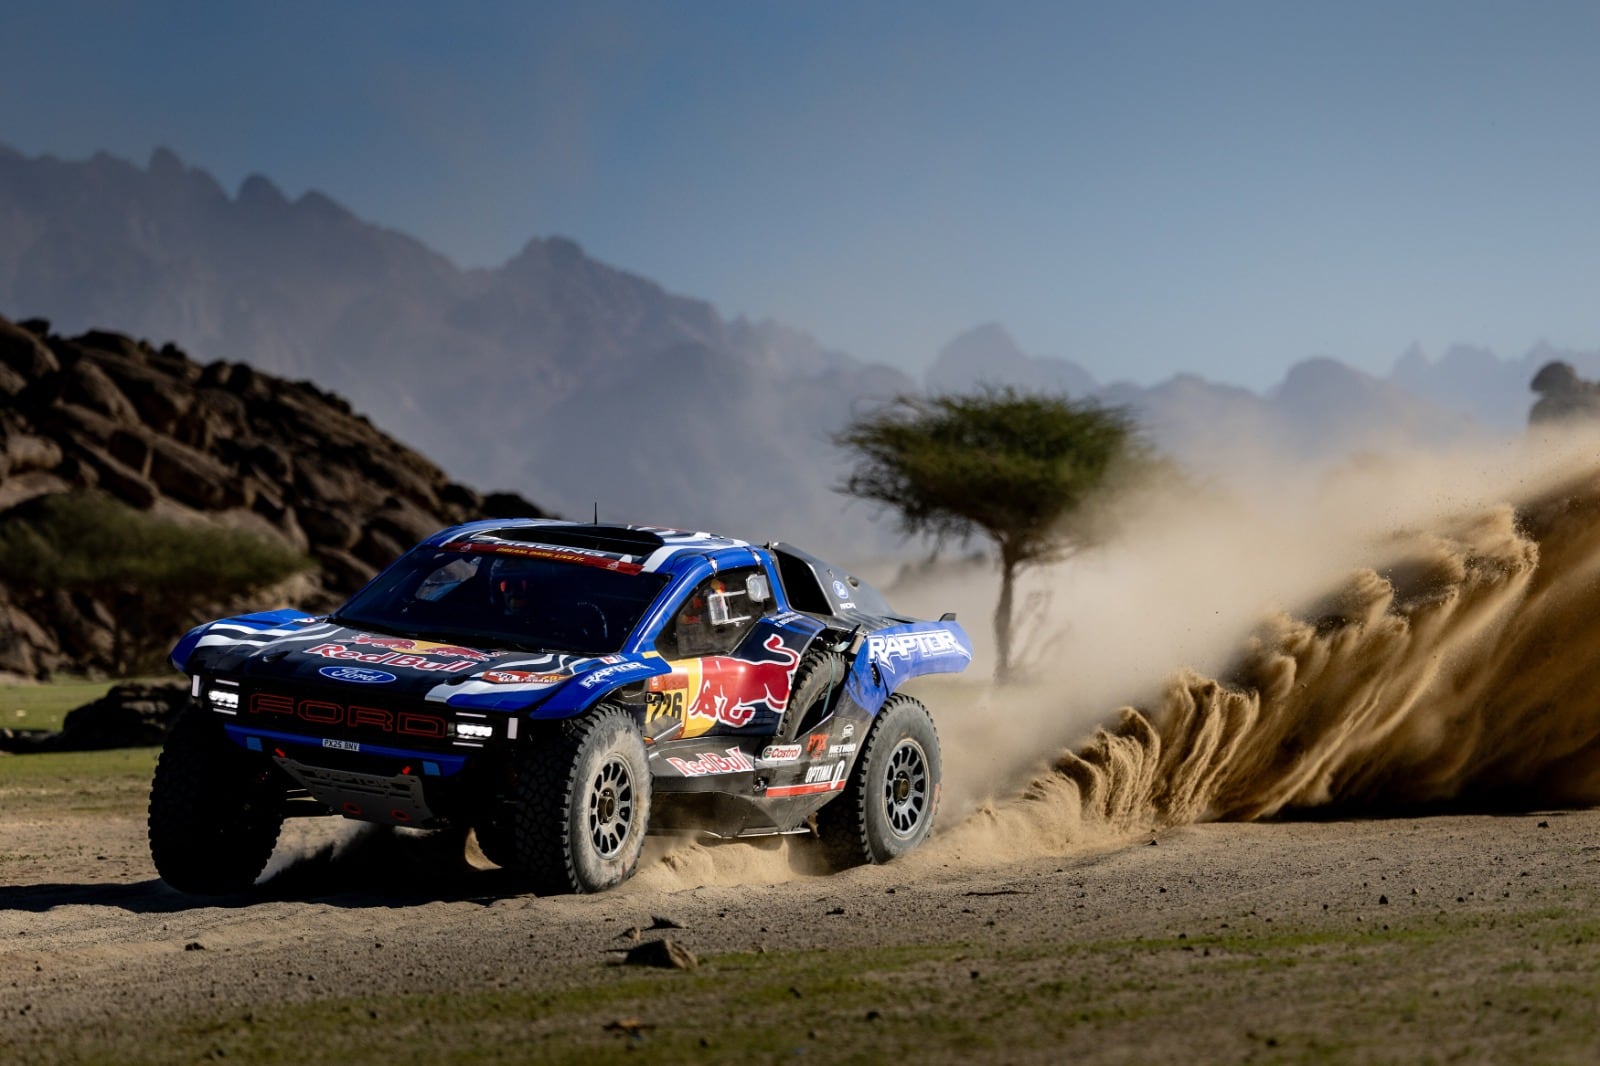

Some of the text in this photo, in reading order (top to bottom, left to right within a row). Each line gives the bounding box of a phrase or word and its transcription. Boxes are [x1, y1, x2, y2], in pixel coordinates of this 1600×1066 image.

[867, 630, 971, 674] RAPTOR
[331, 667, 381, 683] Ford
[578, 661, 652, 689] RAPTOR
[250, 693, 446, 739] FORD
[771, 747, 799, 760] Castrol
[828, 744, 857, 754] METHOD
[805, 764, 834, 783] OPTIMA
